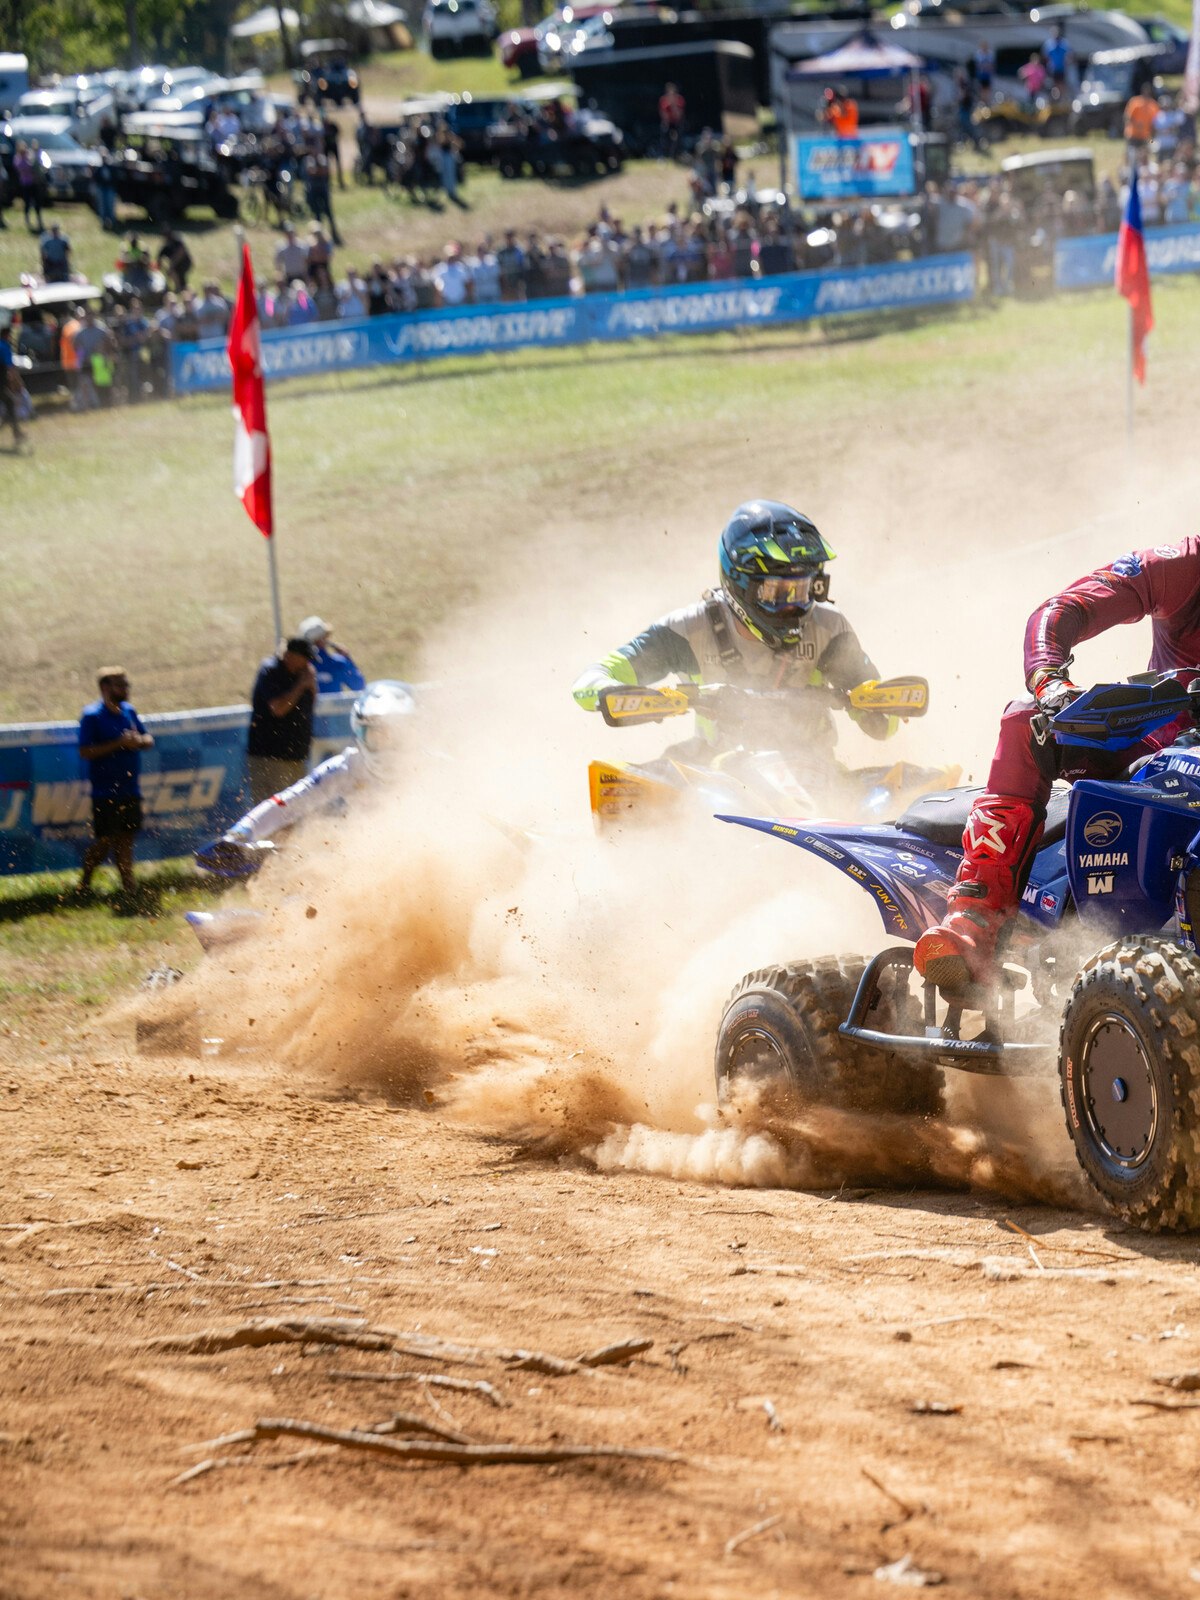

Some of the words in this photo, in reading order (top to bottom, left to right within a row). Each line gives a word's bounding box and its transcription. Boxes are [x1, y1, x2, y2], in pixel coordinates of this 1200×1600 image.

[1116, 707, 1174, 725] POWERMADD
[32, 766, 226, 826] WIECO
[944, 849, 964, 860] FACT
[1079, 852, 1129, 868] YAMAHA
[890, 862, 927, 879] ASV
